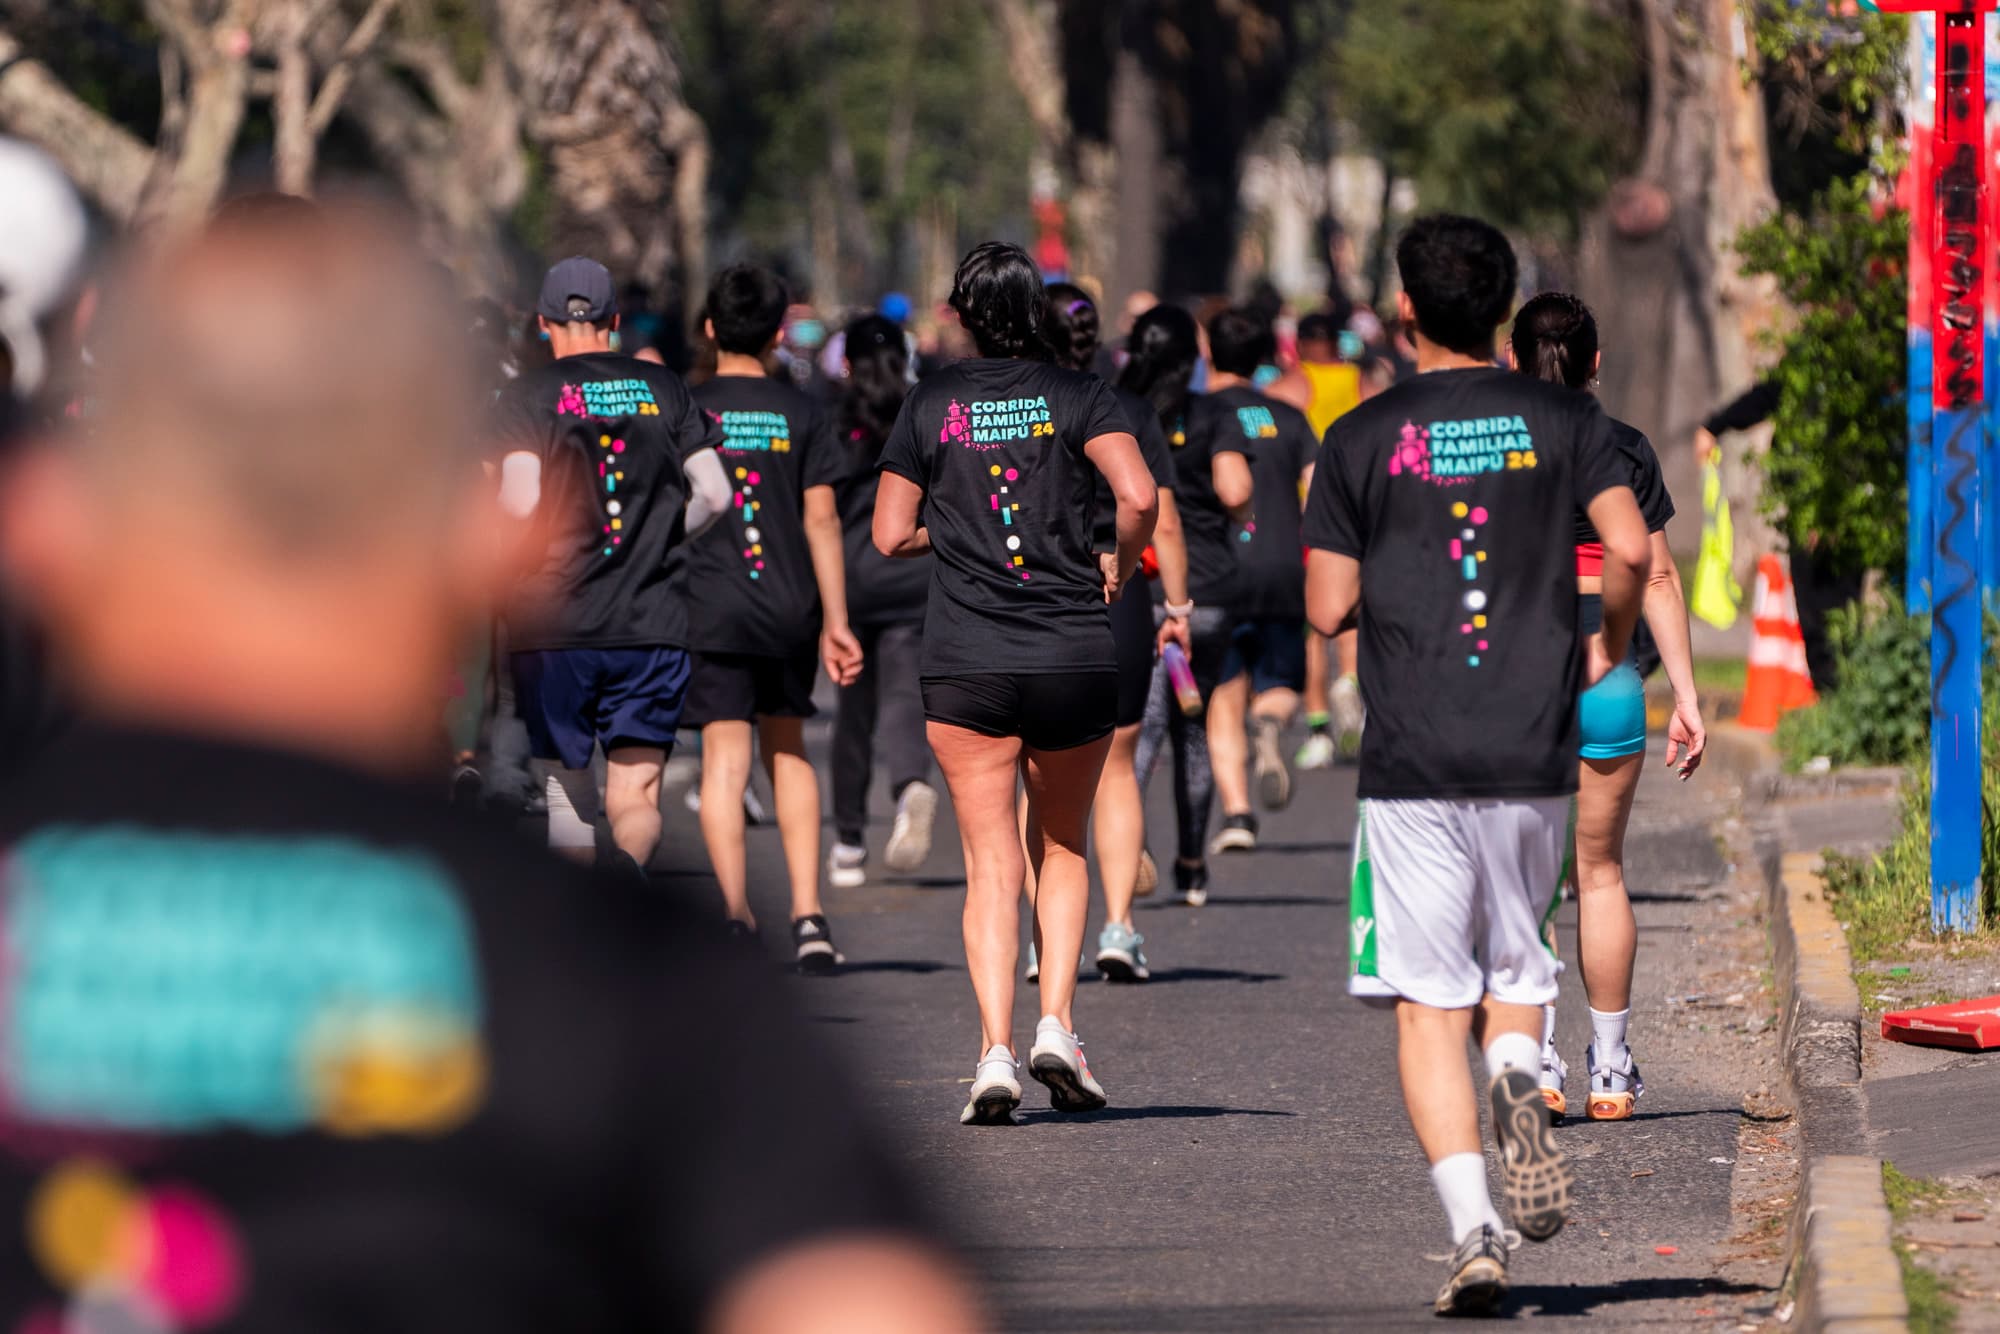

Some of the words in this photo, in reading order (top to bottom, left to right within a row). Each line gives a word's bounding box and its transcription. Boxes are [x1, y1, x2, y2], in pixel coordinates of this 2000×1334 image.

[582, 379, 650, 394] CORRIDA
[584, 391, 656, 405] FAMILIAR
[971, 396, 1048, 414] CORRIDA
[972, 410, 1051, 428] FAMILIAR
[1430, 415, 1528, 439] CORRIDA
[973, 422, 1029, 442] MAIPÚ
[1032, 421, 1055, 438] 24
[1432, 433, 1533, 457] FAMILIAR
[1432, 450, 1505, 475] MAIPÚ
[1507, 450, 1538, 470] 24
